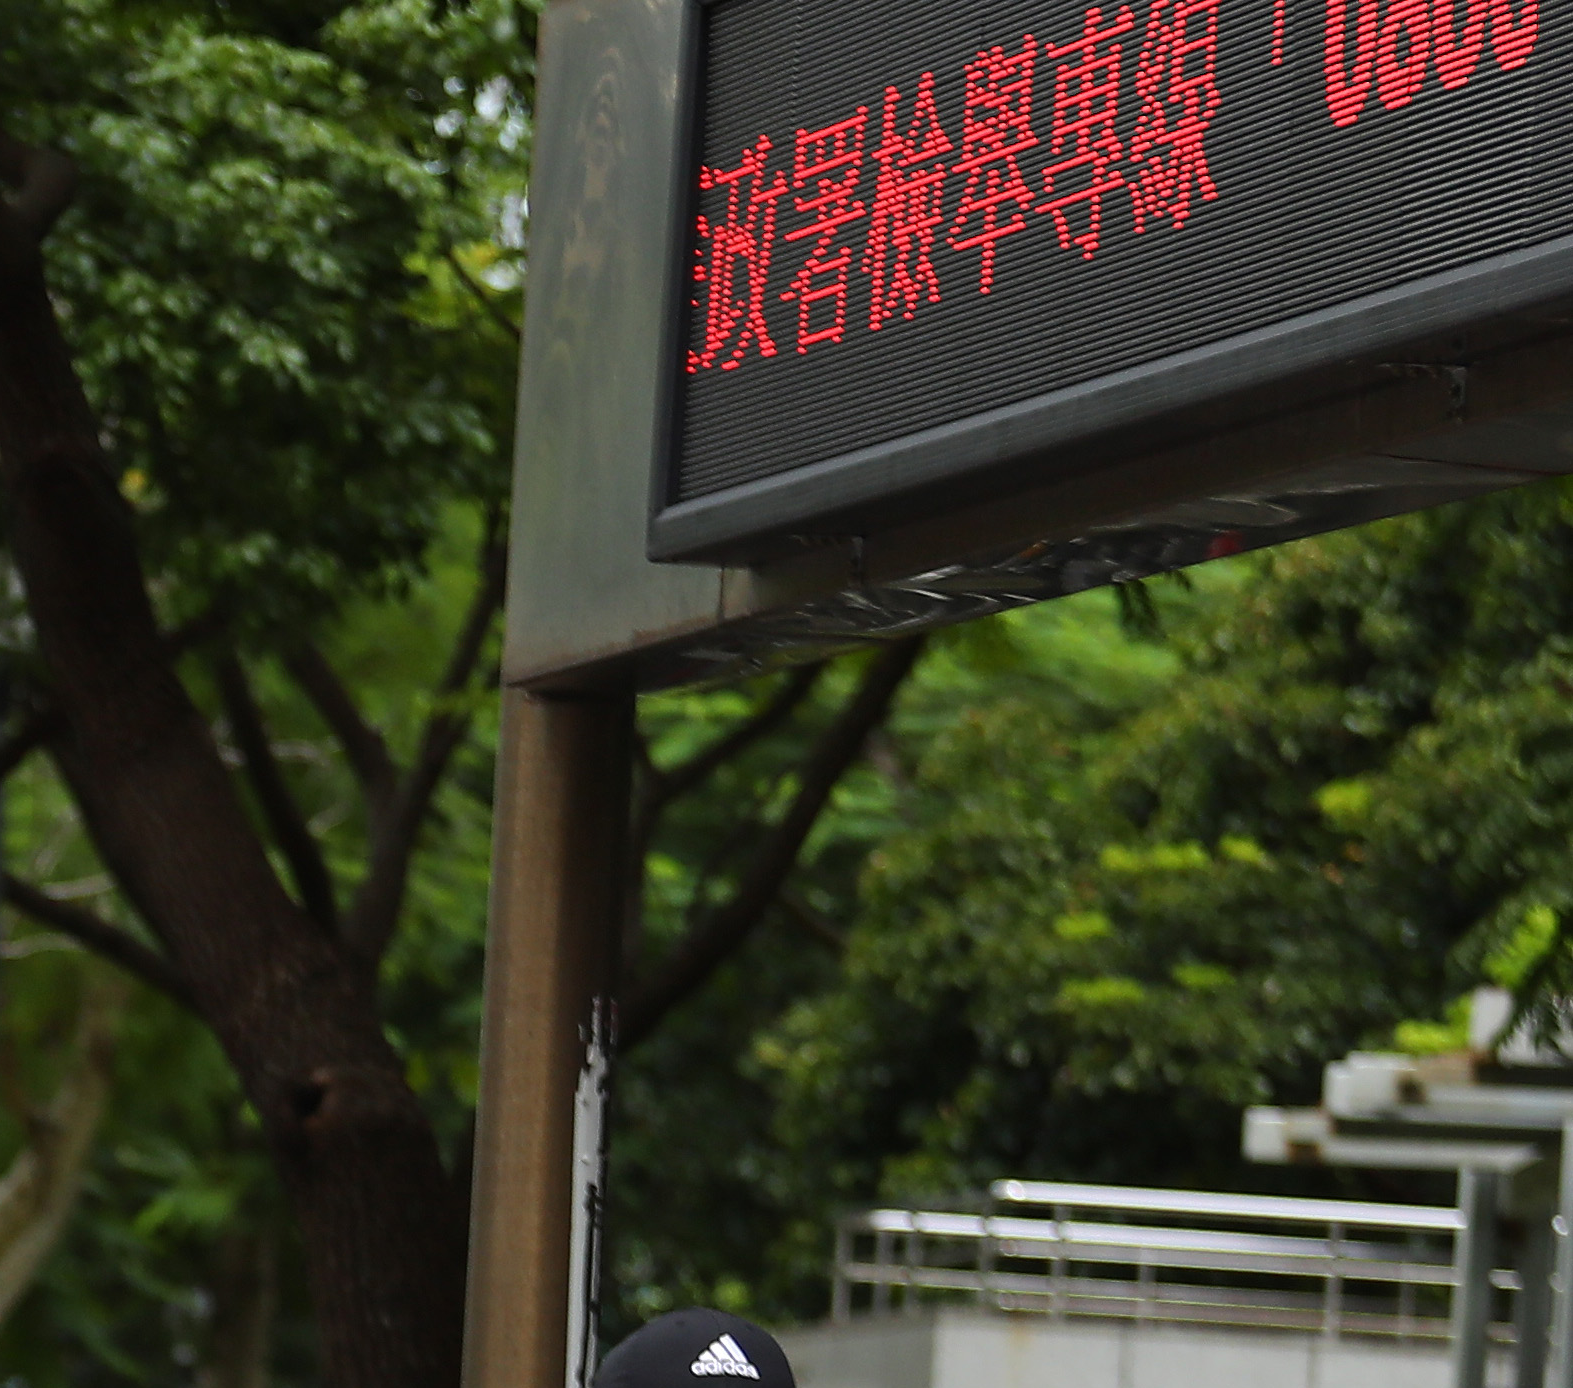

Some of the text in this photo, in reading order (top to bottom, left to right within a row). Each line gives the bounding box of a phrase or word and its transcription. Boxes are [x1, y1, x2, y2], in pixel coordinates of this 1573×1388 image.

[686, 0, 1222, 373] 政署檢舉專線
[690, 1359, 761, 1381] adidas
